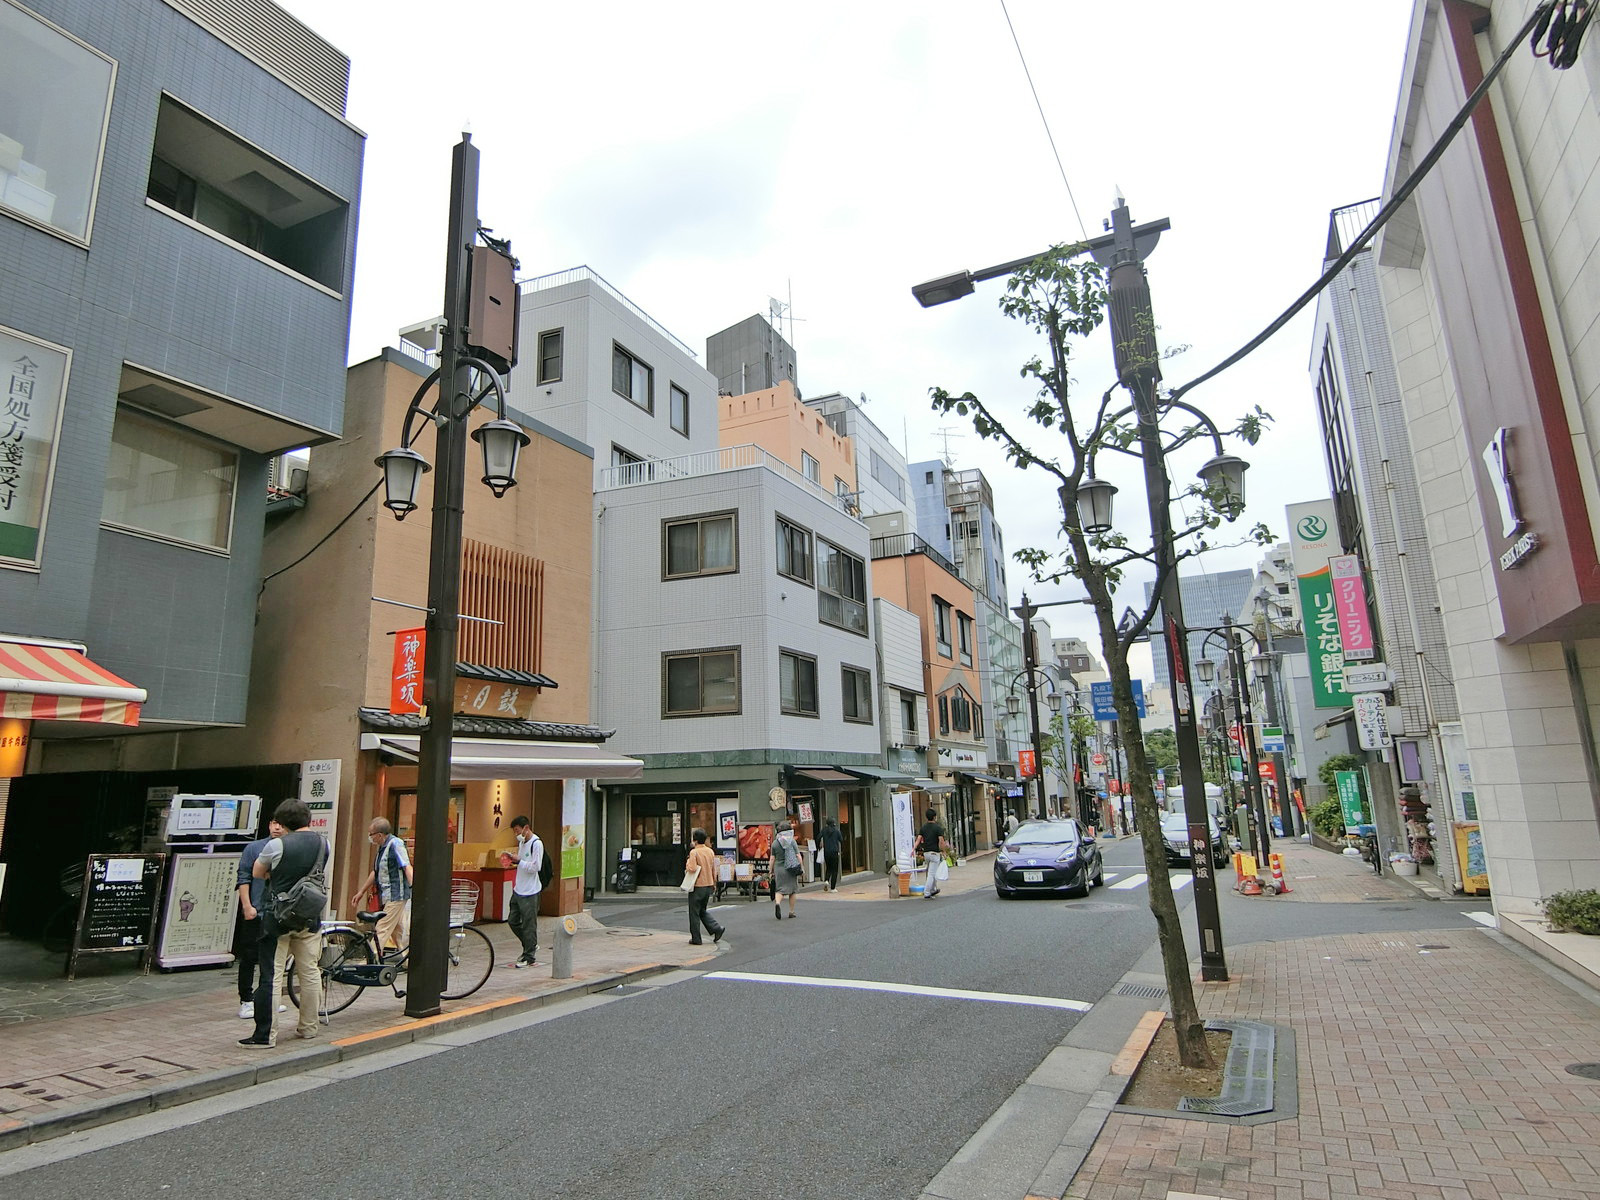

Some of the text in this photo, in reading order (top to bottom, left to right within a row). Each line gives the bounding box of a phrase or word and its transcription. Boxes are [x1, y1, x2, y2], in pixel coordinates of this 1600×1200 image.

[1302, 542, 1328, 550] RESONA
[1313, 592, 1347, 694] りそな銀行
[1342, 580, 1363, 647] クリーニング
[396, 635, 422, 708] 神楽坂
[1374, 697, 1390, 745] ふとん仕立直し
